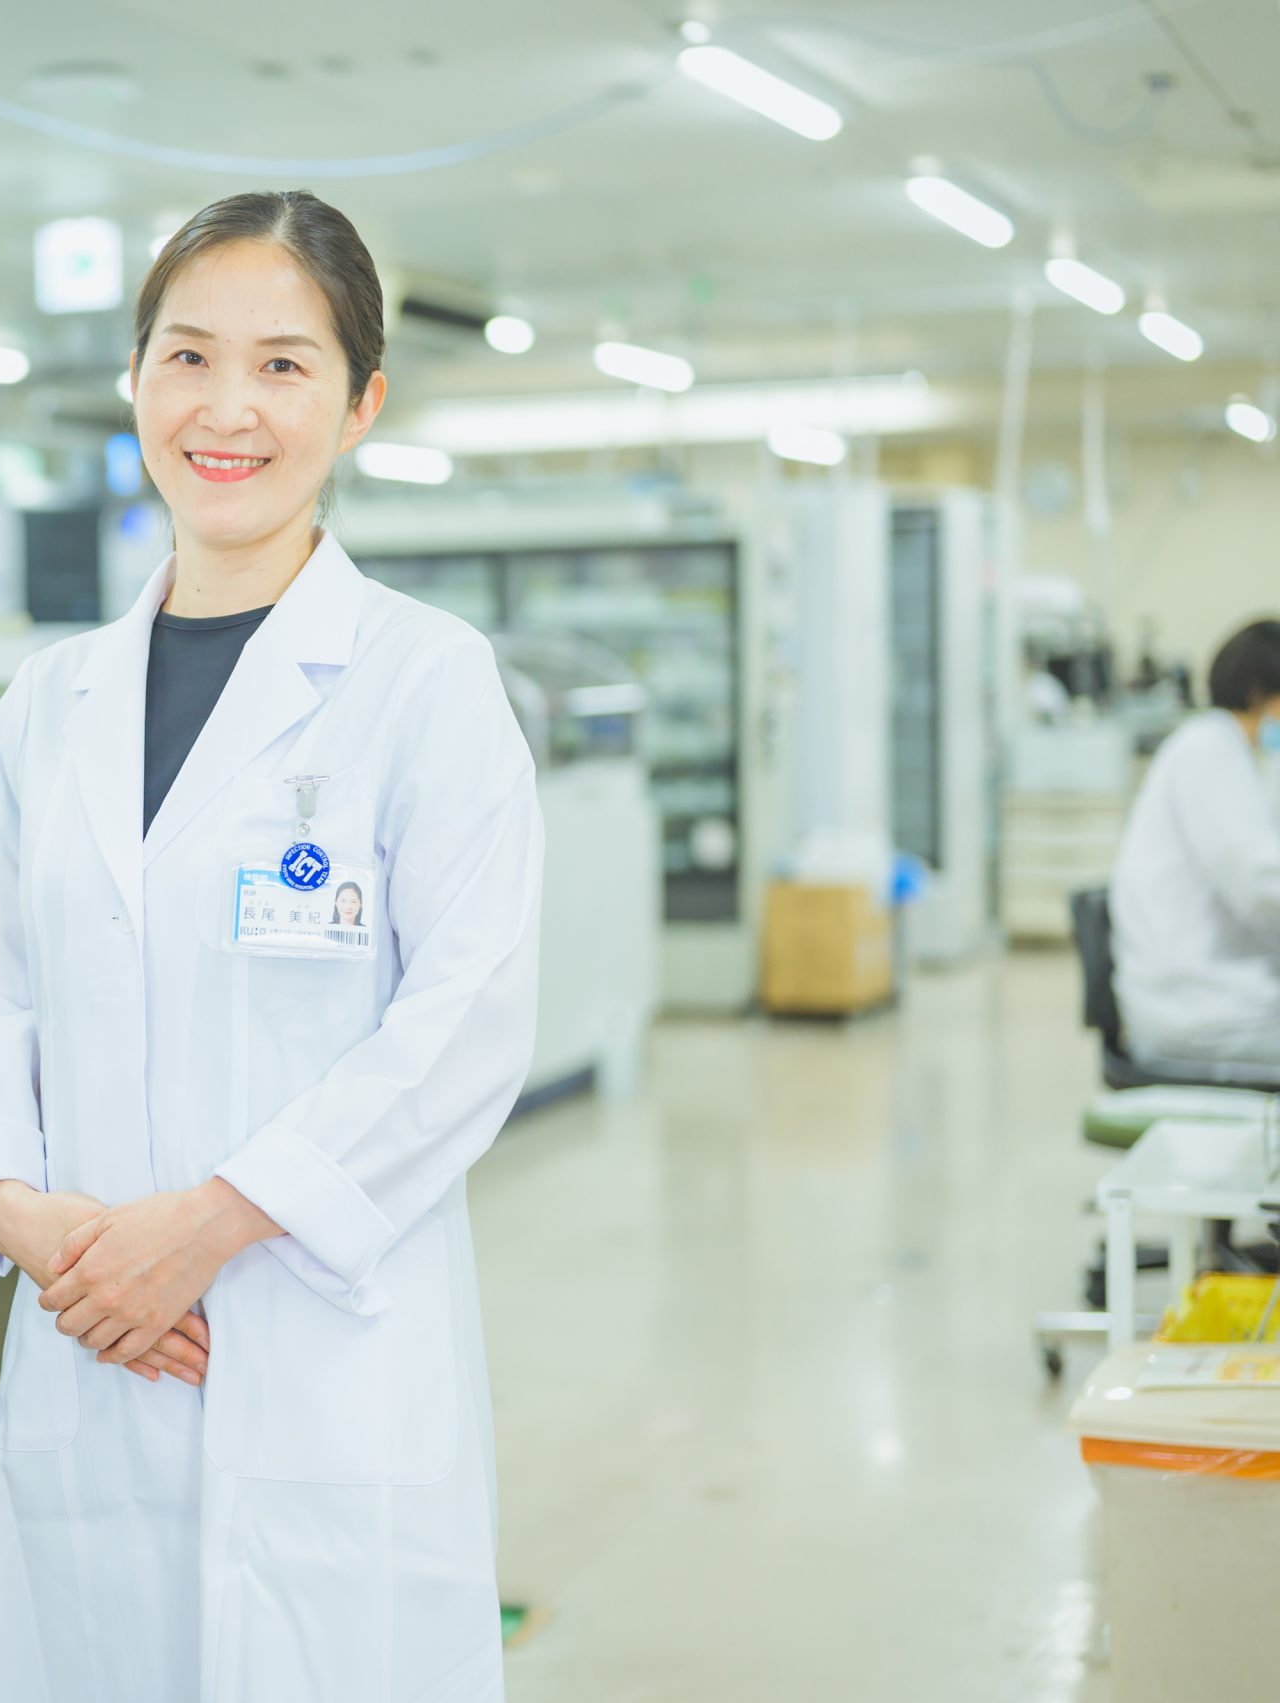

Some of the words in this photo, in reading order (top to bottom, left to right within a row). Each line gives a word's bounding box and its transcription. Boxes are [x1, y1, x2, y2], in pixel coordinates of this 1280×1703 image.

[284, 844, 311, 860] INFECTION
[312, 846, 329, 869] CONTROL
[288, 849, 323, 883] ICT
[315, 871, 328, 885] TEAM
